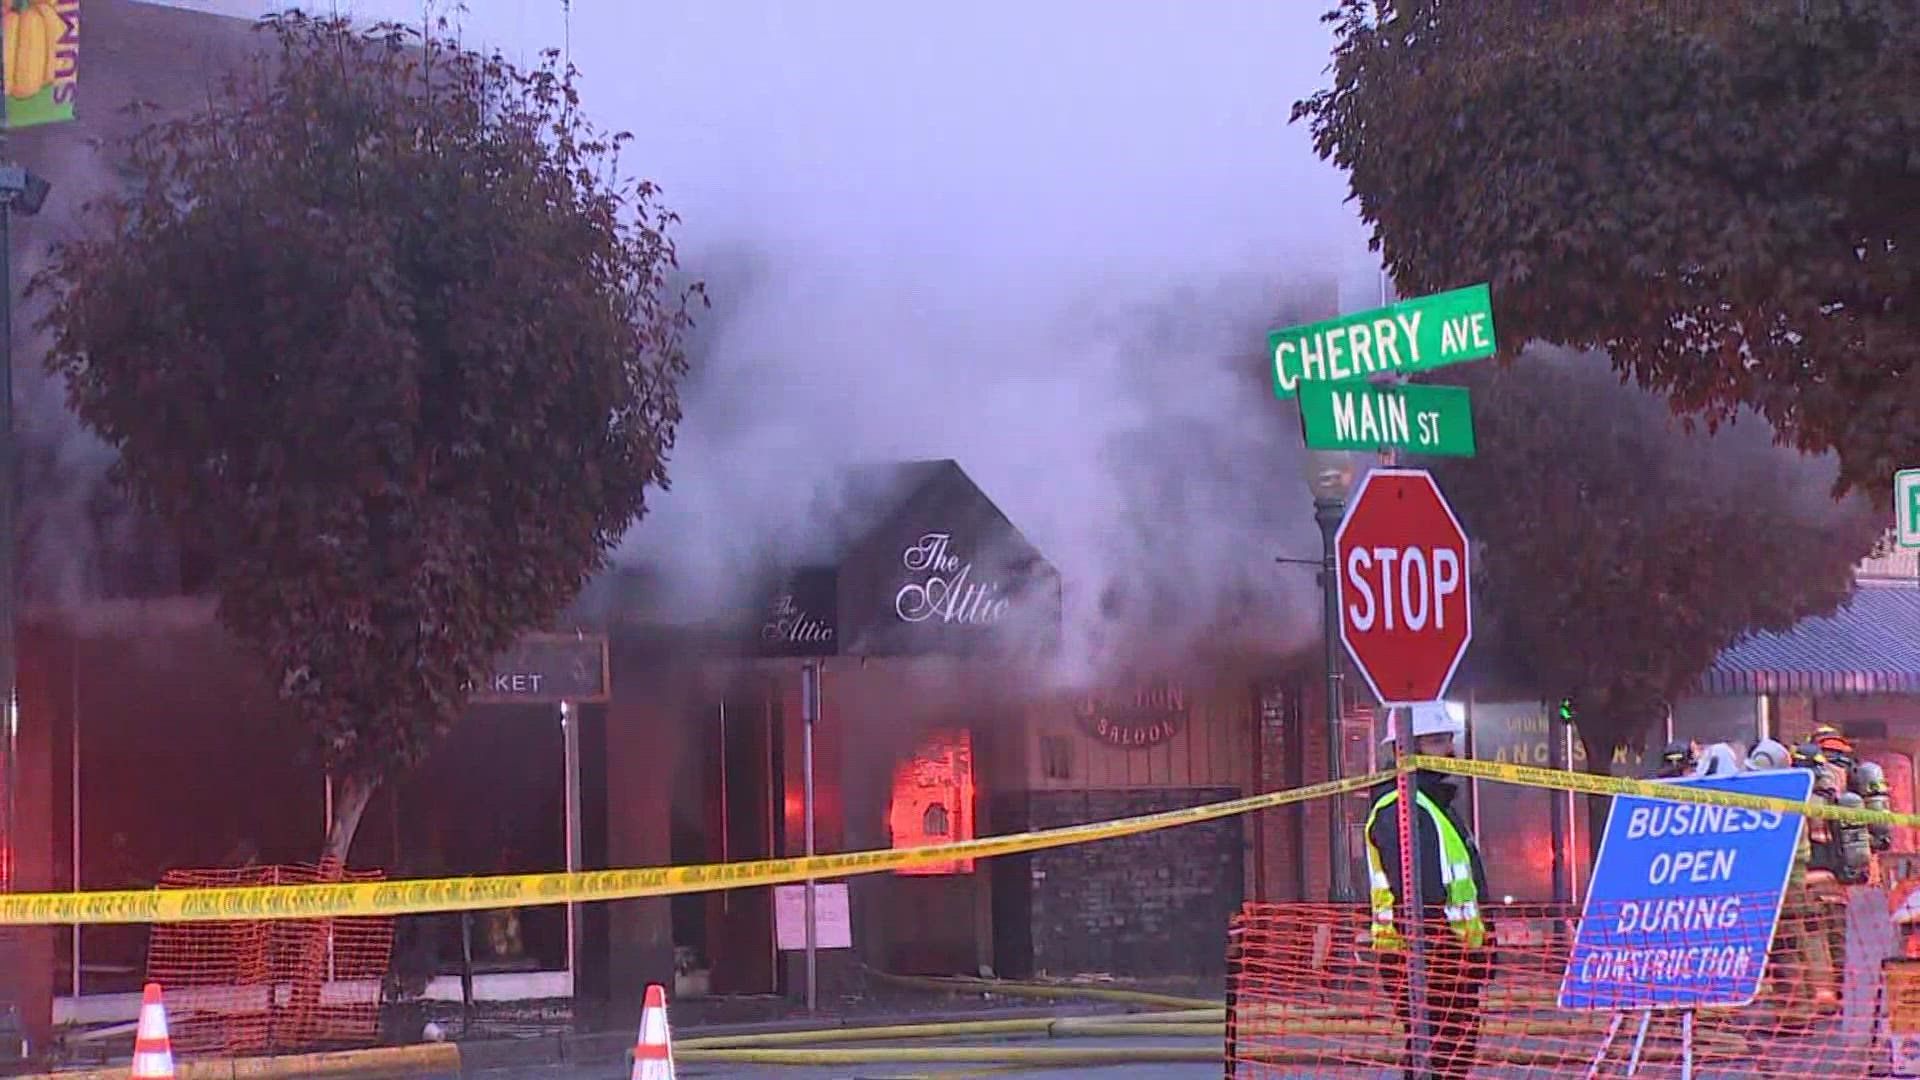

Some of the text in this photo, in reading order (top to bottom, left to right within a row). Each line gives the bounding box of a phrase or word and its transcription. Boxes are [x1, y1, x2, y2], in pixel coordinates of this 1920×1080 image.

[53, 0, 80, 104] SUM
[1274, 310, 1490, 391] CHERRY AVE
[1331, 391, 1440, 445] MAIN ST
[904, 532, 961, 571] The
[895, 562, 1011, 624] Attic
[1347, 546, 1459, 632] STOP
[760, 609, 834, 643] Attic
[1097, 717, 1175, 745] SALOON
[1626, 804, 1783, 840] BUSINESS
[1649, 848, 1737, 886] OPEN
[1616, 896, 1741, 935] DURING
[1580, 944, 1753, 984] CONSTRUCTION
